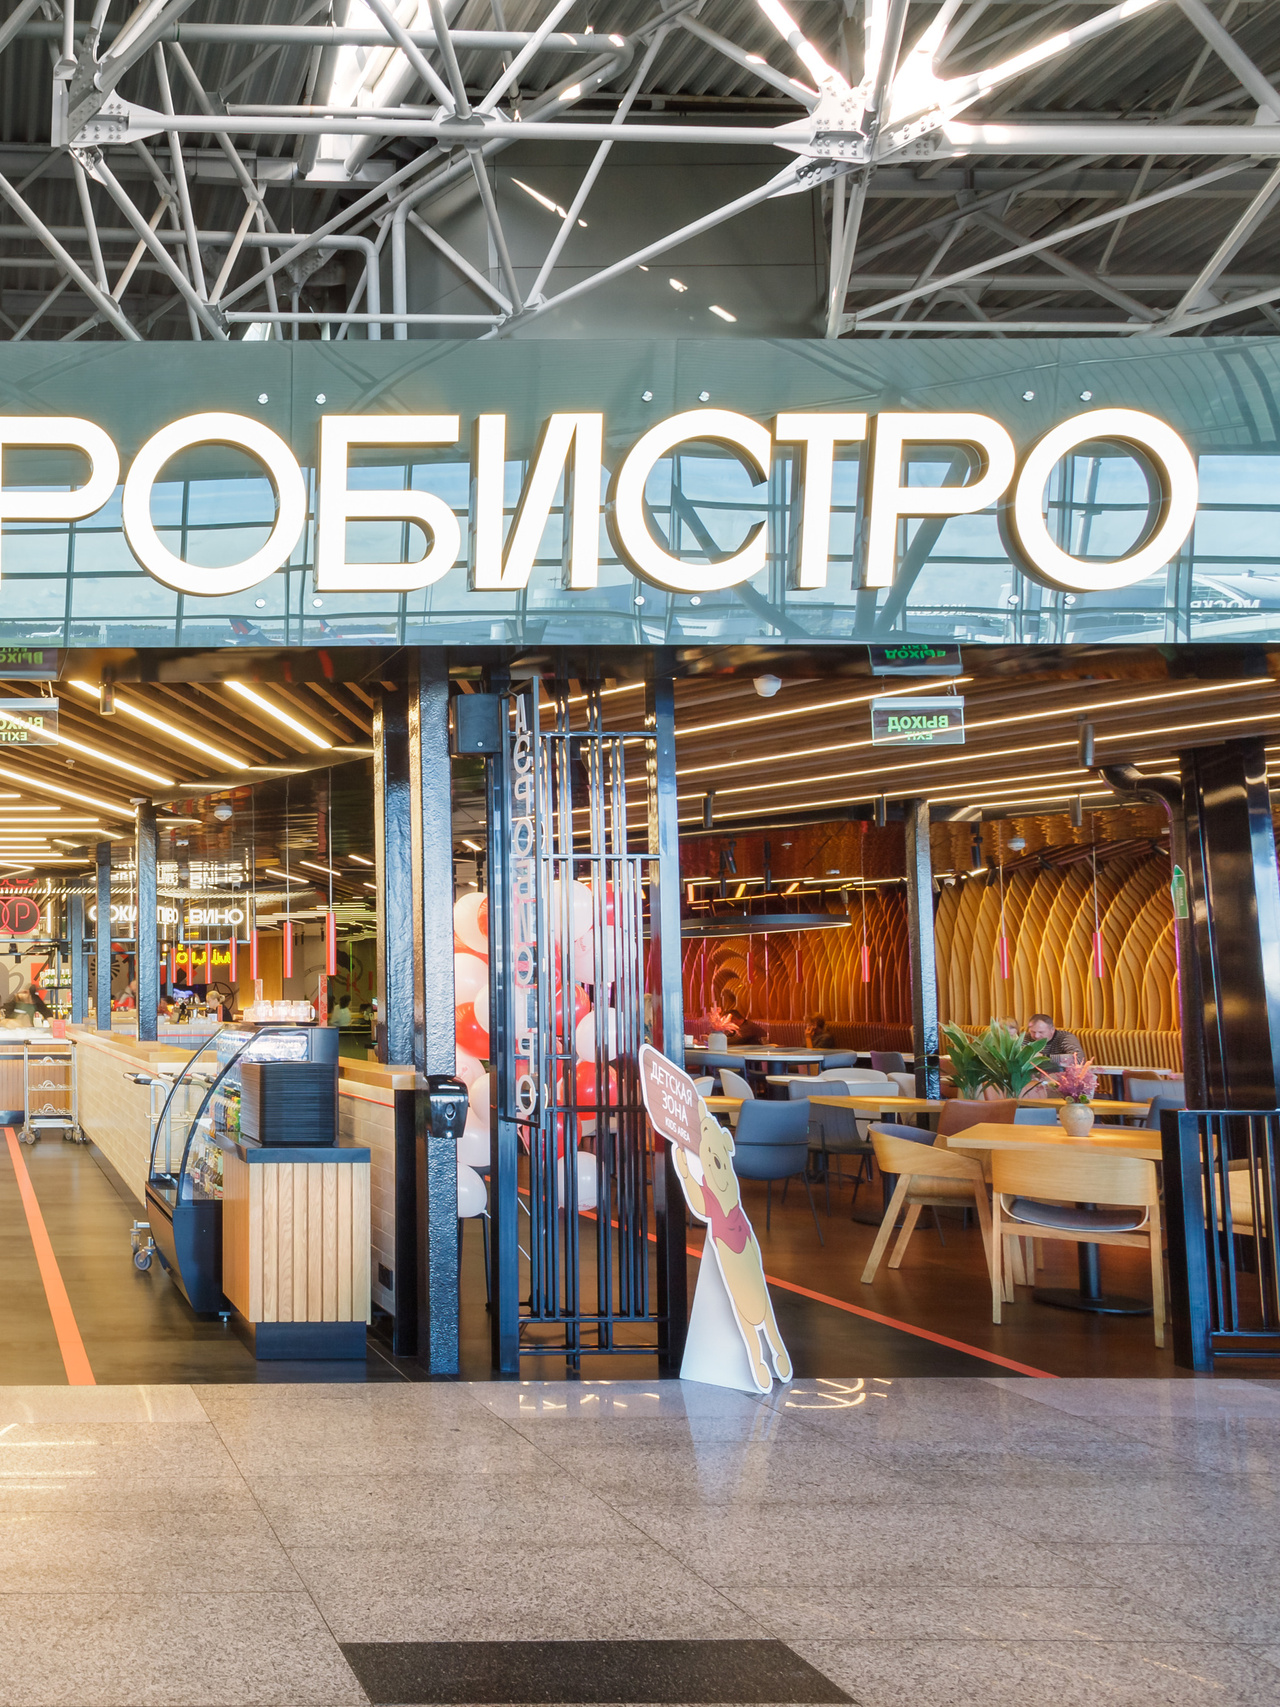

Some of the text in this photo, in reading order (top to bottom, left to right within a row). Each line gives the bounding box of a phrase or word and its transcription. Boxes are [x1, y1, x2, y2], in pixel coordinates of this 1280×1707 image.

[189, 907, 244, 925] ВИНО
[650, 1060, 693, 1108] ДЕТСКАЯ
[661, 1090, 689, 1127] ЗОНА
[664, 1116, 691, 1144] KIDS AREA
